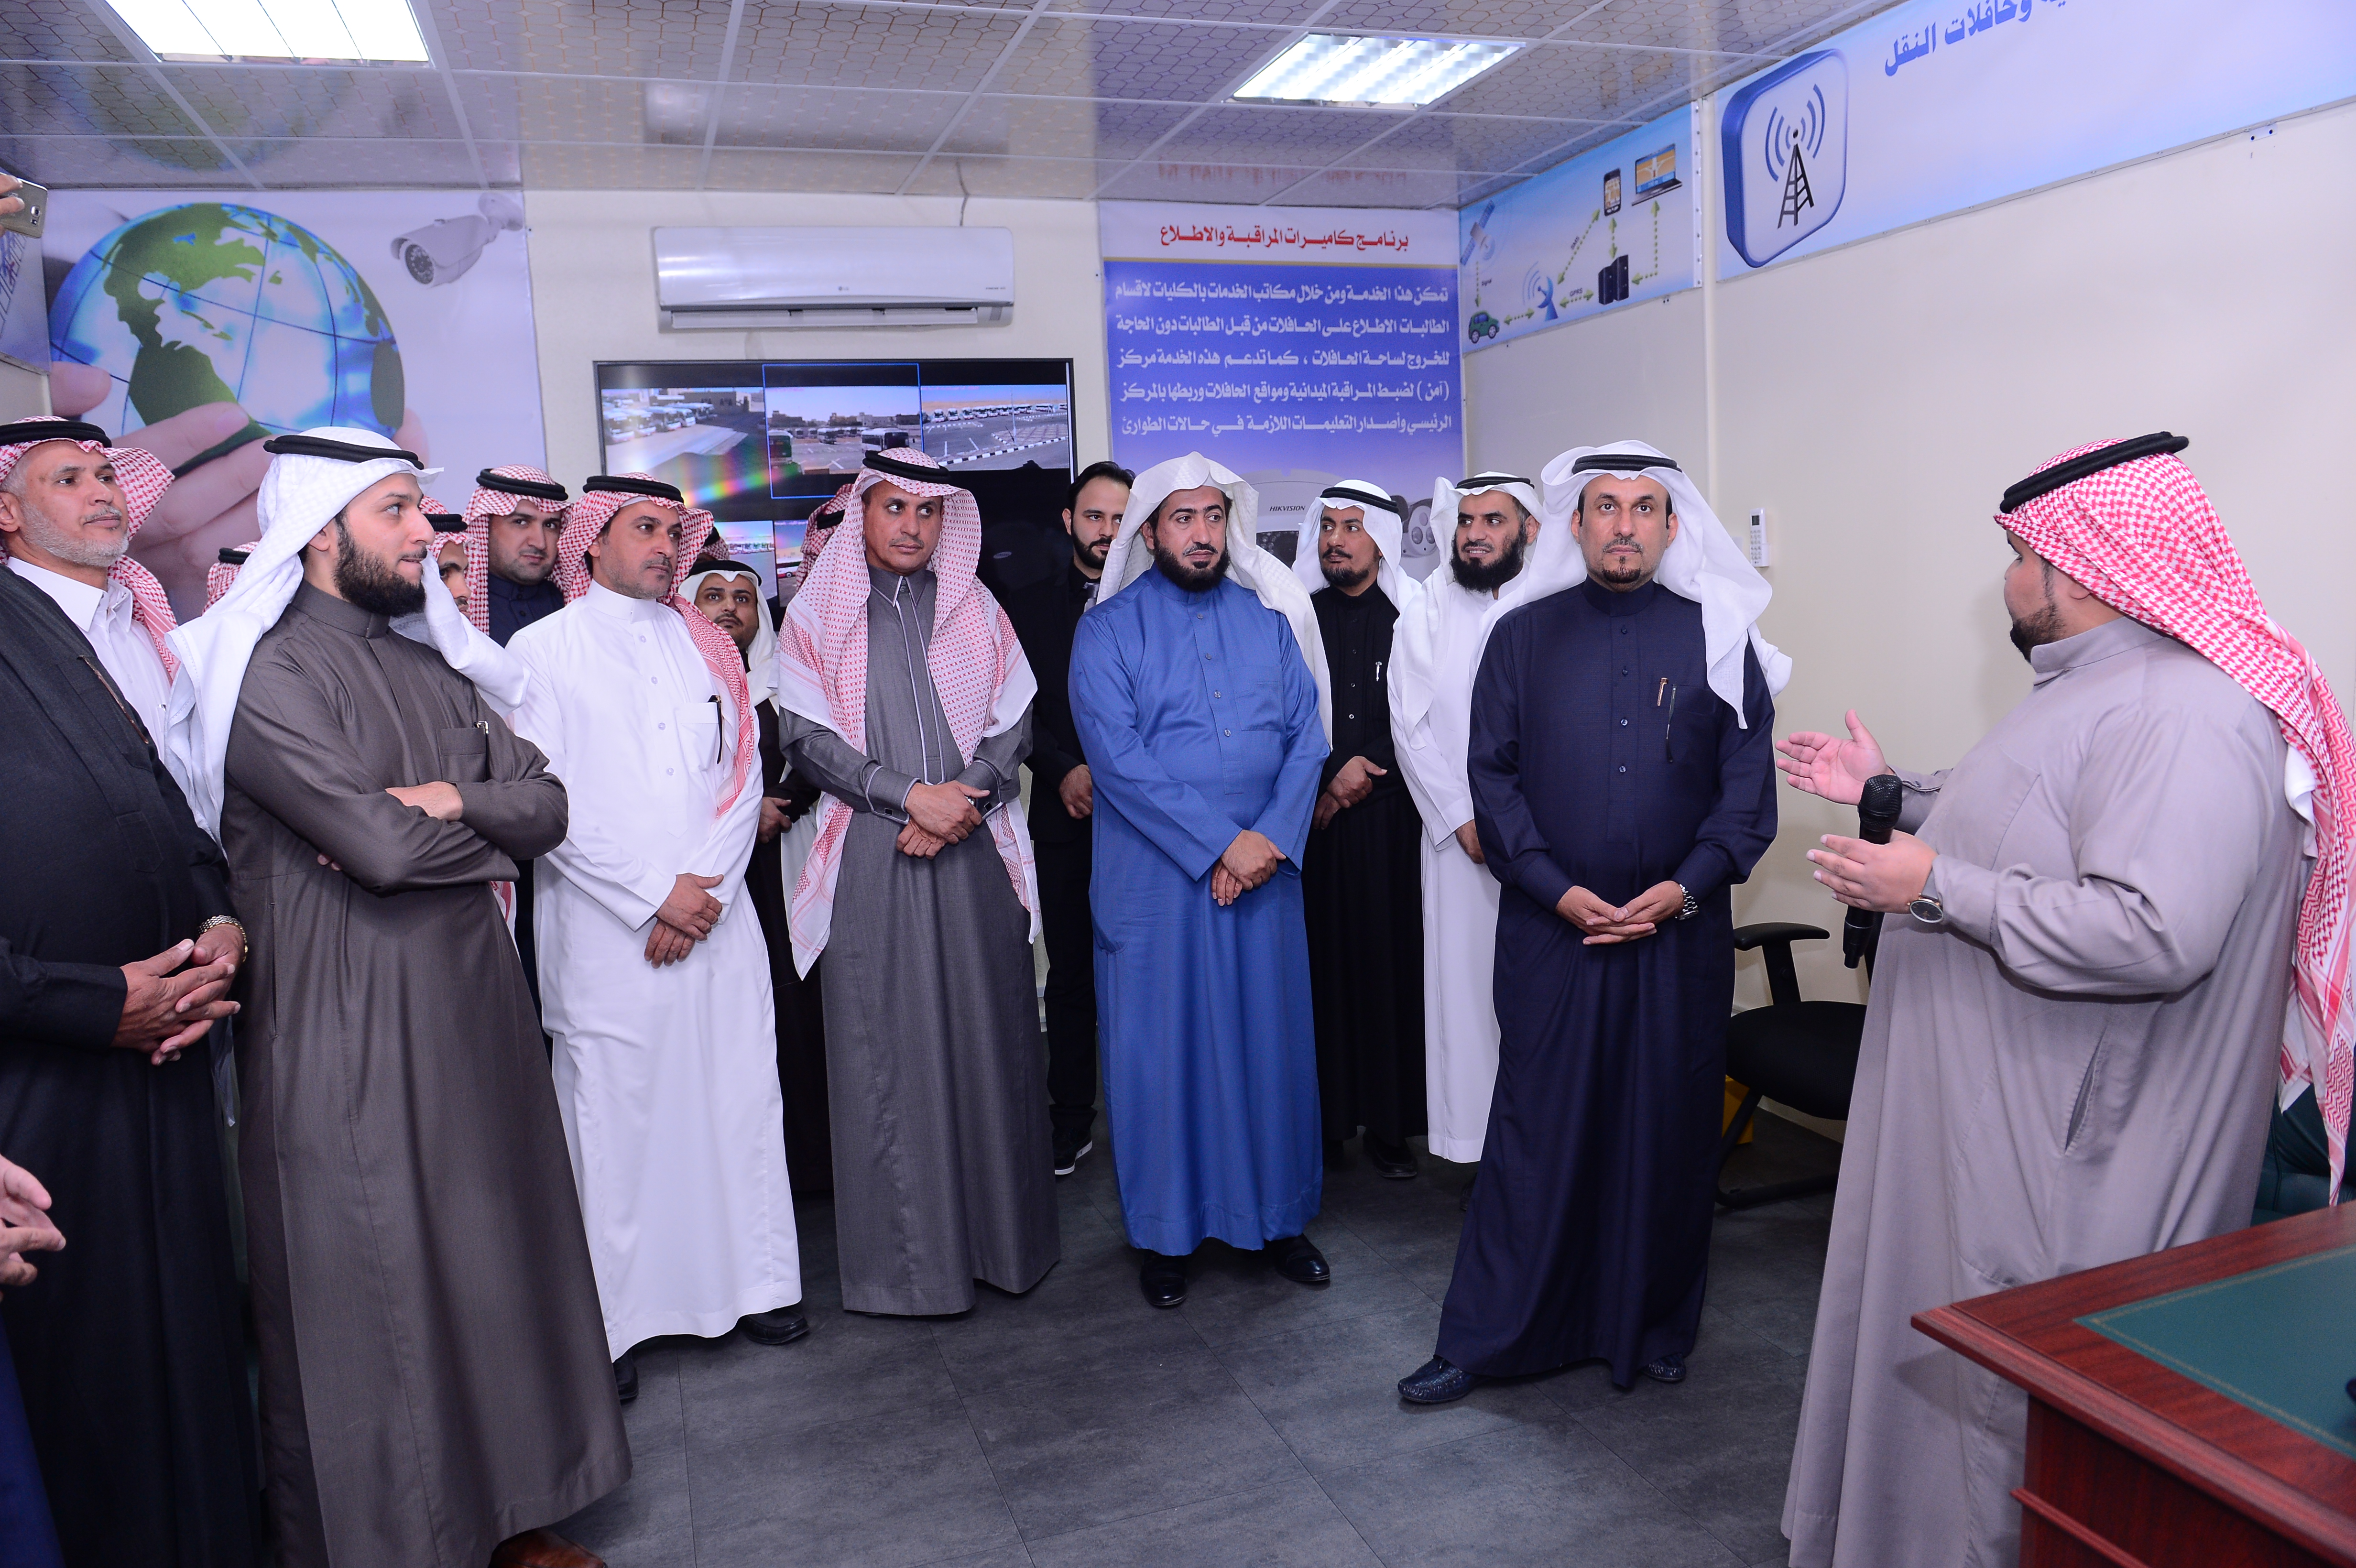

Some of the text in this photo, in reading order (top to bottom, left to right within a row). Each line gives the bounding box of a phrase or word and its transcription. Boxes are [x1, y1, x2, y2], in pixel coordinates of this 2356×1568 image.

[1885, 22, 1936, 76] النقل
[1160, 225, 1409, 251] برنامج كاميرات المراقبة والاطلاع
[1153, 282, 1207, 302] بالكليات
[1207, 283, 1252, 299] الخدمات
[1253, 283, 1296, 303] مكاتب
[1297, 283, 1324, 304] خلال
[1324, 285, 1346, 305] ومن
[1346, 284, 1391, 301] الخدمة
[1413, 286, 1449, 306] تمكن
[1115, 314, 1450, 338] الطالبات الاطلاع على الحافلات من قبل الطالبات دون الحاجة
[1117, 348, 1156, 369] مركز
[1156, 348, 1196, 364] الخدمة
[1197, 348, 1221, 364] هذه
[1224, 348, 1266, 368] تدعم
[1312, 349, 1362, 366] الحافلات
[1362, 349, 1406, 365] لساحة
[1407, 350, 1450, 370] للخروج
[1120, 382, 1167, 402] بالمركز
[1167, 382, 1204, 402] وربطها
[1205, 381, 1251, 399] الحافلات
[1254, 381, 1289, 403] ومواقع
[1289, 382, 1331, 401] الميدانية
[1331, 381, 1376, 402] المراقبة
[1377, 381, 1415, 402] لضبط
[1122, 416, 1167, 436] الطوارئ
[1167, 415, 1210, 431] حالات
[1211, 414, 1244, 437] في
[1246, 414, 1291, 434] اللازمة
[1292, 414, 1357, 434] التعليمات
[1407, 413, 1451, 436] الرئيسي
